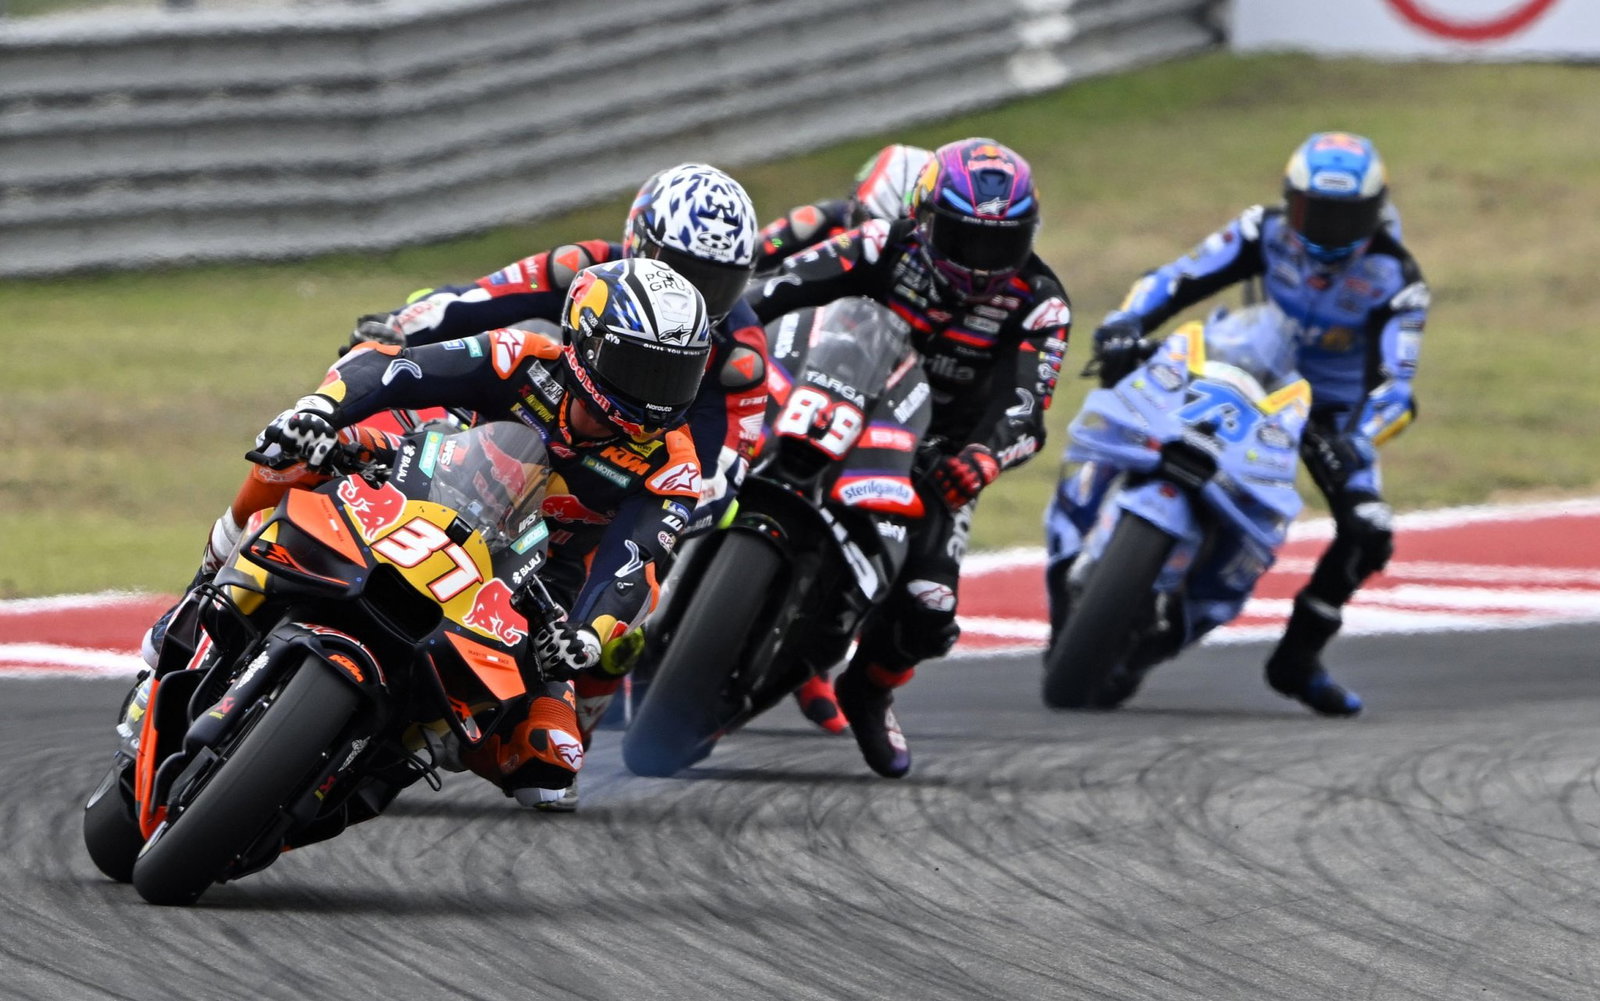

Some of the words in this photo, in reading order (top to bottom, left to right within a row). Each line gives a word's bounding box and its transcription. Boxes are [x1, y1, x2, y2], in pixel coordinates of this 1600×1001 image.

[561, 341, 587, 382] Red
[581, 374, 611, 413] Bull
[806, 370, 866, 410] TARGA
[774, 386, 865, 460] 89
[396, 455, 412, 483] BAJAJ
[600, 445, 651, 476] KTM
[370, 516, 484, 603] 37
[519, 554, 542, 578] BAJAJ
[328, 653, 365, 683] KTM
